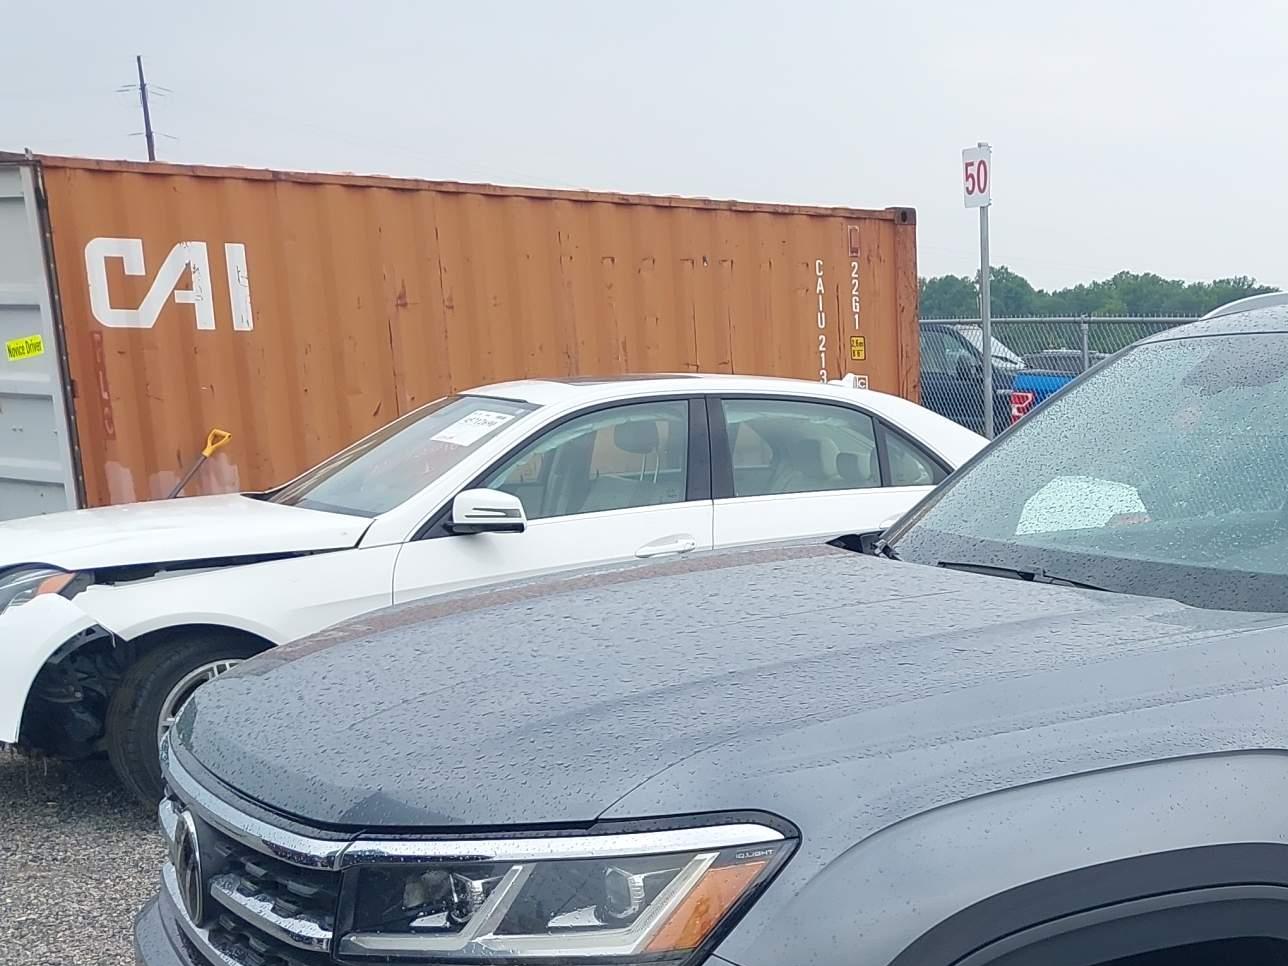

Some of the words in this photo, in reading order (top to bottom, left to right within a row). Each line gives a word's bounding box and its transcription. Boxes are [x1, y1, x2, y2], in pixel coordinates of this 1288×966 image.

[964, 159, 988, 196] 50
[84, 237, 254, 331] CAI
[815, 259, 826, 329] CAIU
[850, 261, 860, 330] 22G1
[6, 342, 26, 358] Novice
[25, 339, 42, 354] Driver
